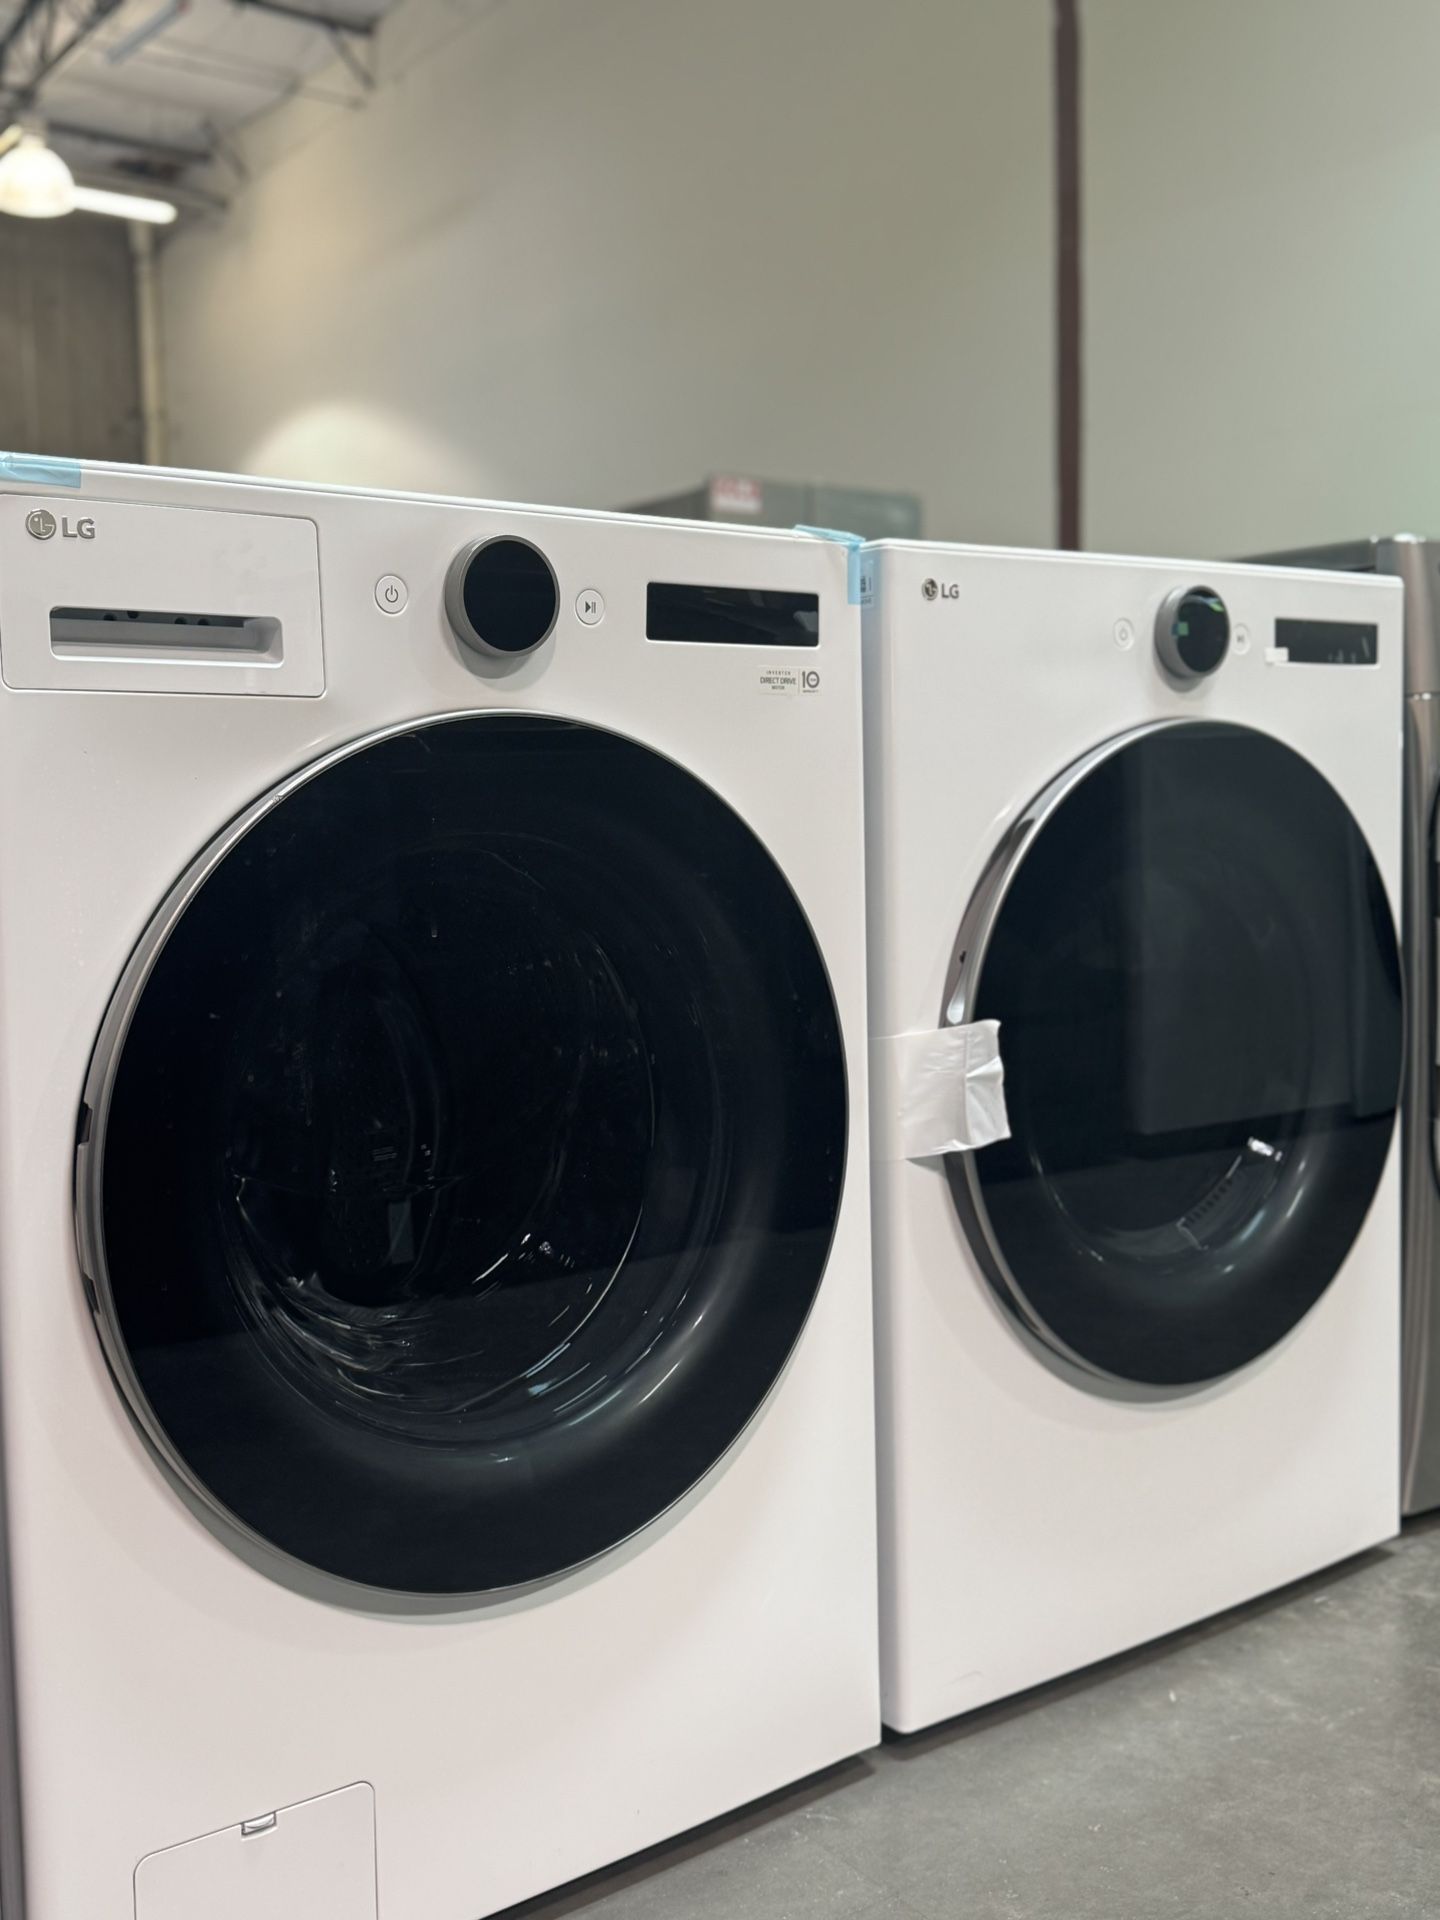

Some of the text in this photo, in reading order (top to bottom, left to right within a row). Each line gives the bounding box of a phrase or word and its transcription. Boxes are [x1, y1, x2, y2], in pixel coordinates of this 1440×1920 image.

[62, 516, 95, 539] LG
[941, 583, 959, 598] LG
[760, 677, 796, 685] DIRECT DRIVE
